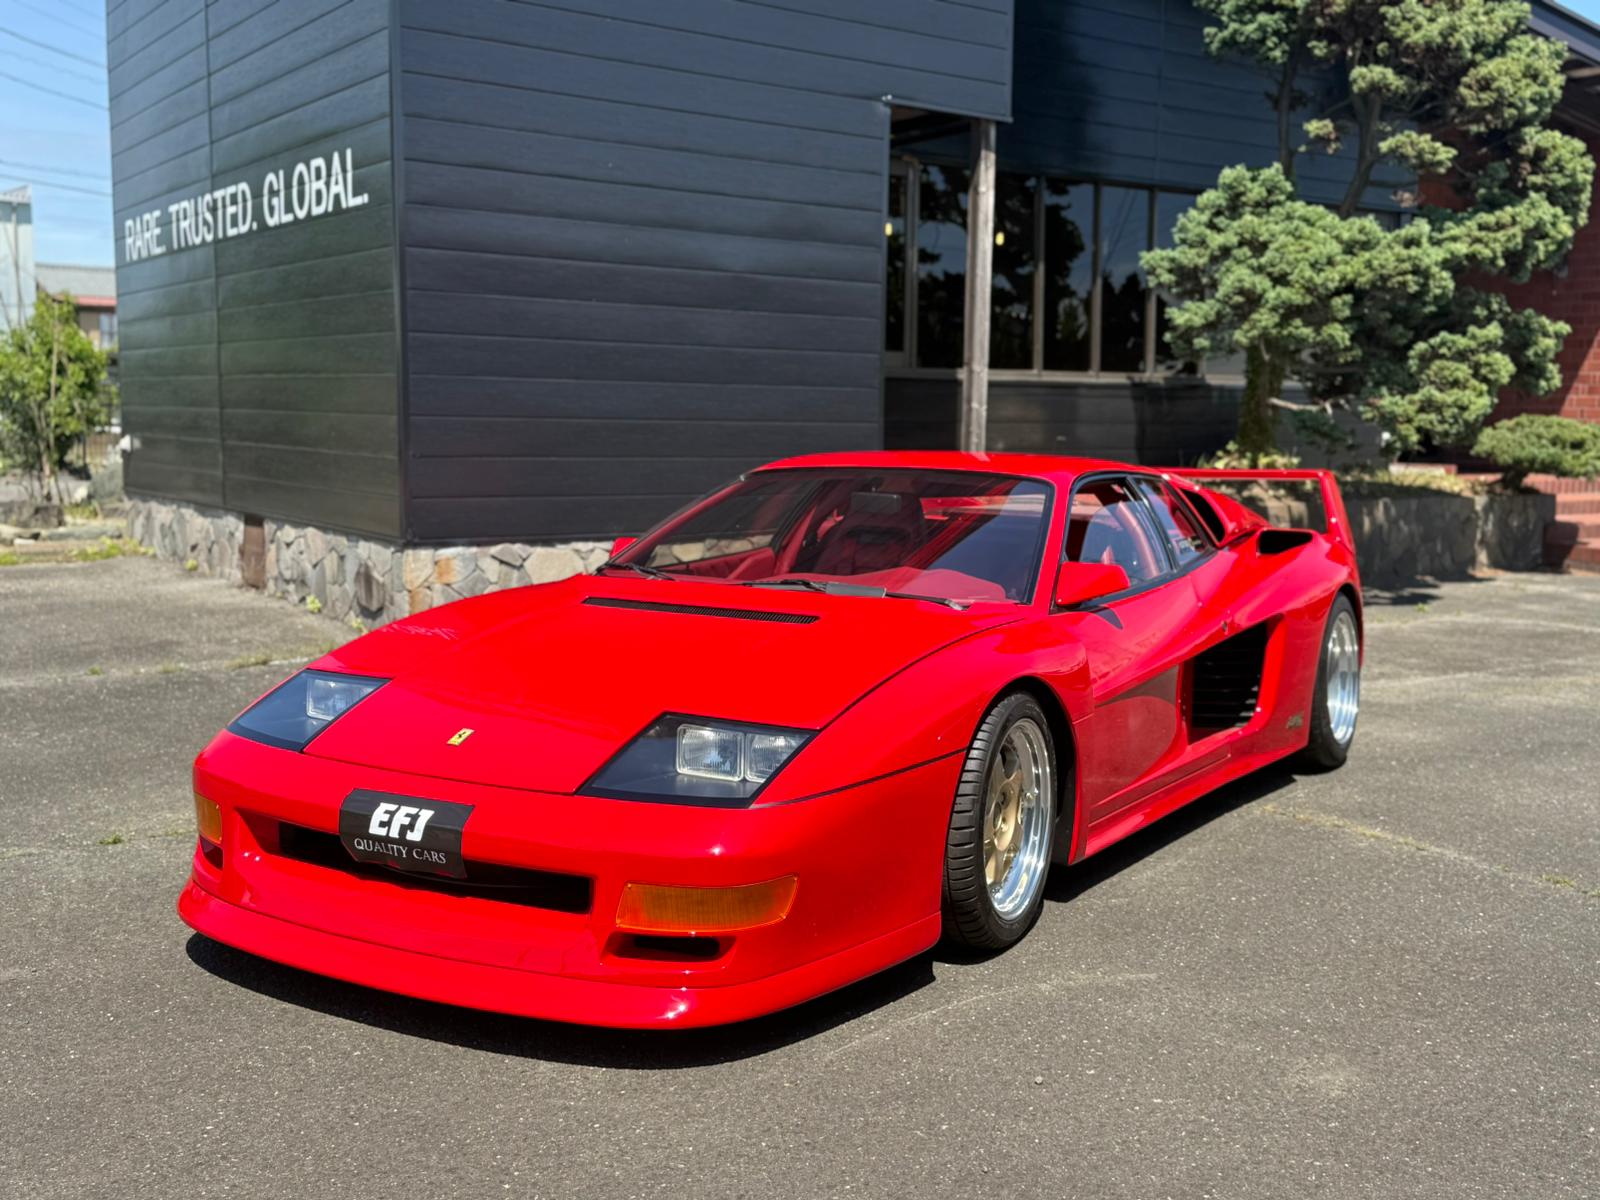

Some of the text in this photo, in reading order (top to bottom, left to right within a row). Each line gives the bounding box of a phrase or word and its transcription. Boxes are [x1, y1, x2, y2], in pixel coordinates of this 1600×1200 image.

[168, 181, 257, 250] TRUSTED.
[262, 147, 369, 227] GLOBAL.
[354, 838, 447, 864] QUALITY CARS
